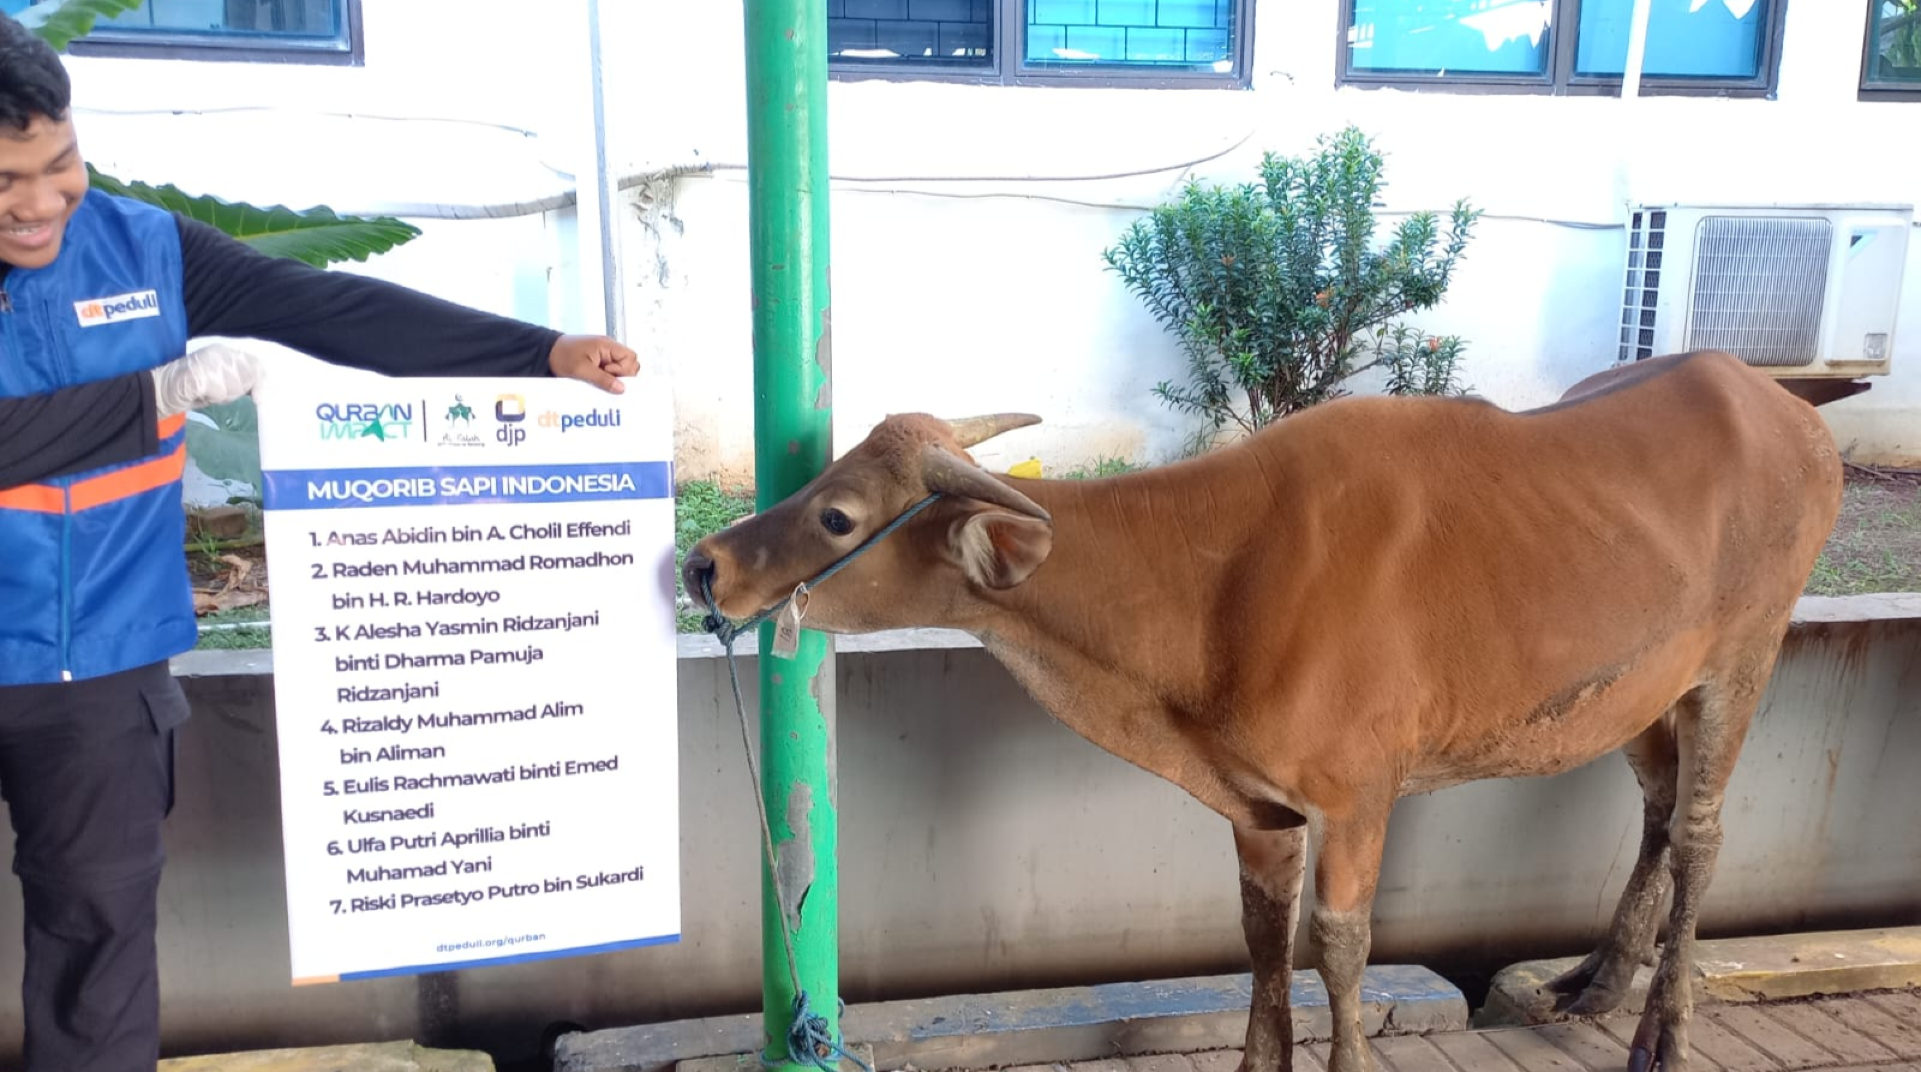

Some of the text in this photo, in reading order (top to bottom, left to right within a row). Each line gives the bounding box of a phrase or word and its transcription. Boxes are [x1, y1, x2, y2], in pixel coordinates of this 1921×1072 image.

[81, 294, 157, 318] dtpeduli
[316, 402, 412, 421] QURBAN
[537, 409, 621, 432] dtpeduli
[496, 423, 526, 447] djp
[308, 472, 636, 502] MUQORIB SAPI INDONESIA
[308, 519, 631, 547] 1. Anas Abidin bin A. Cholil Effendi
[311, 551, 634, 580] 2. Raden Muhammad Romadhon
[332, 588, 501, 610] bin H. R. Hardoyo
[314, 609, 599, 642] 3. K Alesha Yasmin Ridzanjani
[335, 645, 544, 672] binti Dharma Pamuja
[337, 680, 439, 703] Ridzanjani
[320, 700, 584, 735] 4. Rizaldy Muhammad Alim
[340, 744, 446, 765] bin Aliman
[323, 754, 619, 797] 5. Eulis Rachmawati binti Emed
[343, 802, 435, 825] Kusnaedi
[326, 820, 551, 856] 6. Ulfa Putri Aprillia binti
[346, 855, 492, 884] Muhamad Yani
[329, 865, 644, 915] 7. Riski Prasetyo Putro bin Sukardi
[437, 933, 546, 952] dtpeduli.org/qurban
